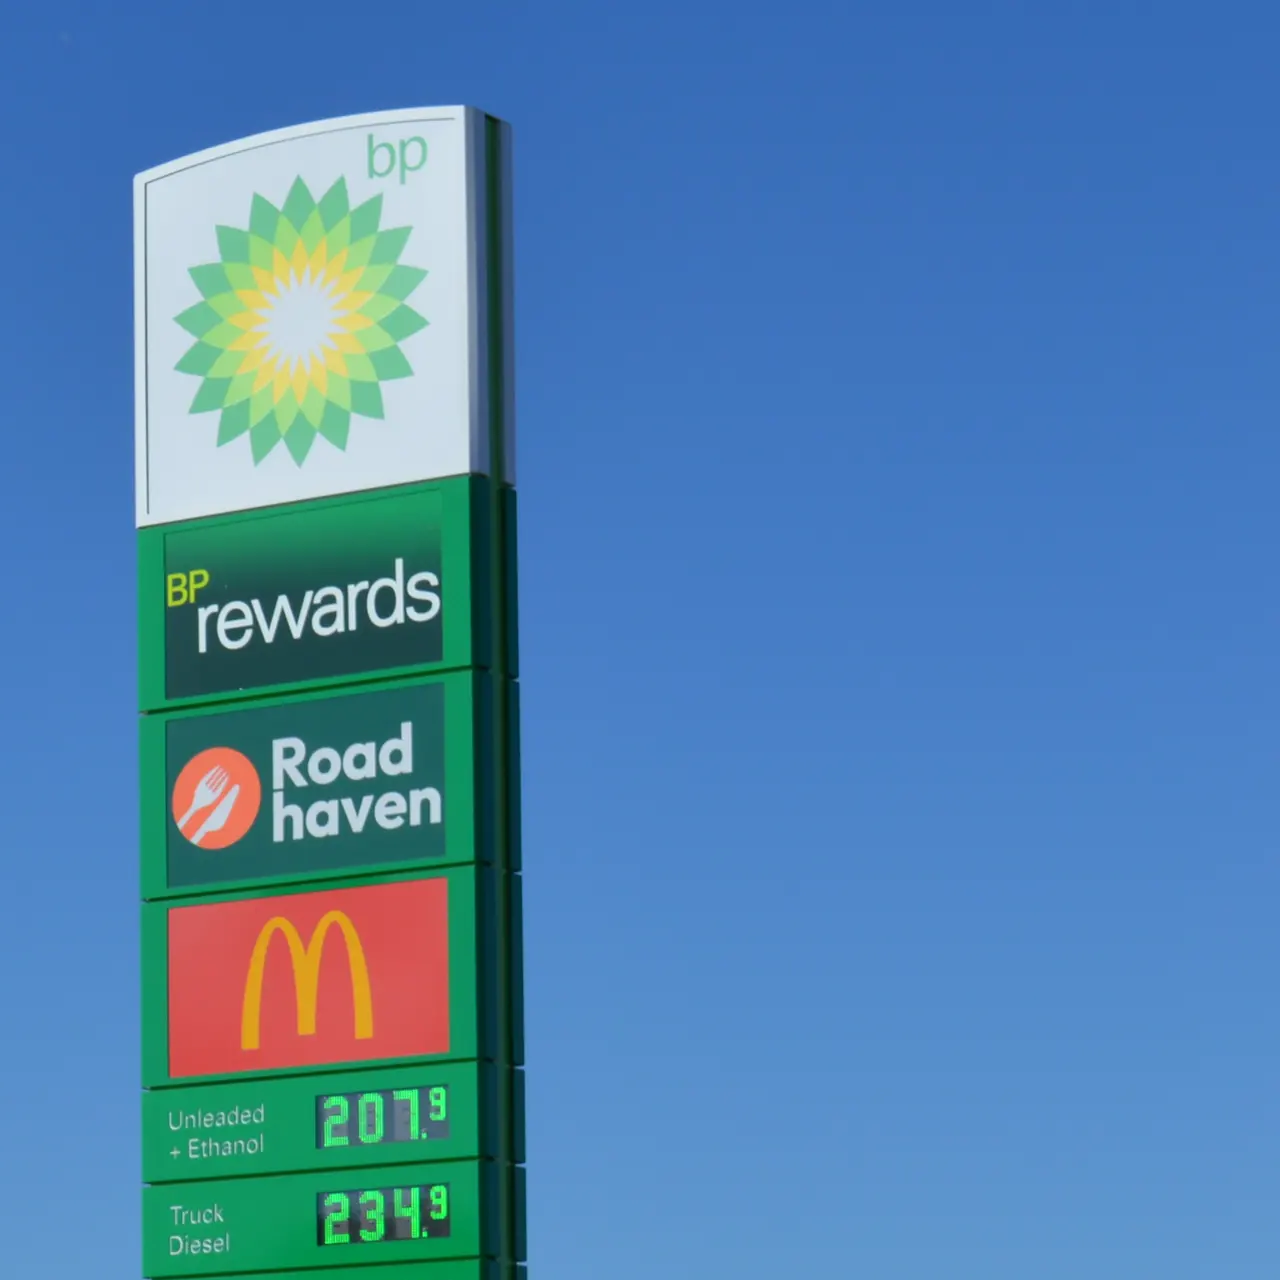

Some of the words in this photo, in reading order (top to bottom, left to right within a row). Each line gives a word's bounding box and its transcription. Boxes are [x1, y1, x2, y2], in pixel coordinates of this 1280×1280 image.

[366, 133, 428, 185] bp
[167, 569, 210, 607] BP
[197, 557, 441, 653] rewards
[272, 721, 413, 790] Road
[272, 786, 442, 843] haven
[168, 1103, 265, 1131] Unleaded
[188, 1134, 264, 1160] Ethanol
[170, 1203, 224, 1226] Truck
[169, 1233, 230, 1256] Diesel
